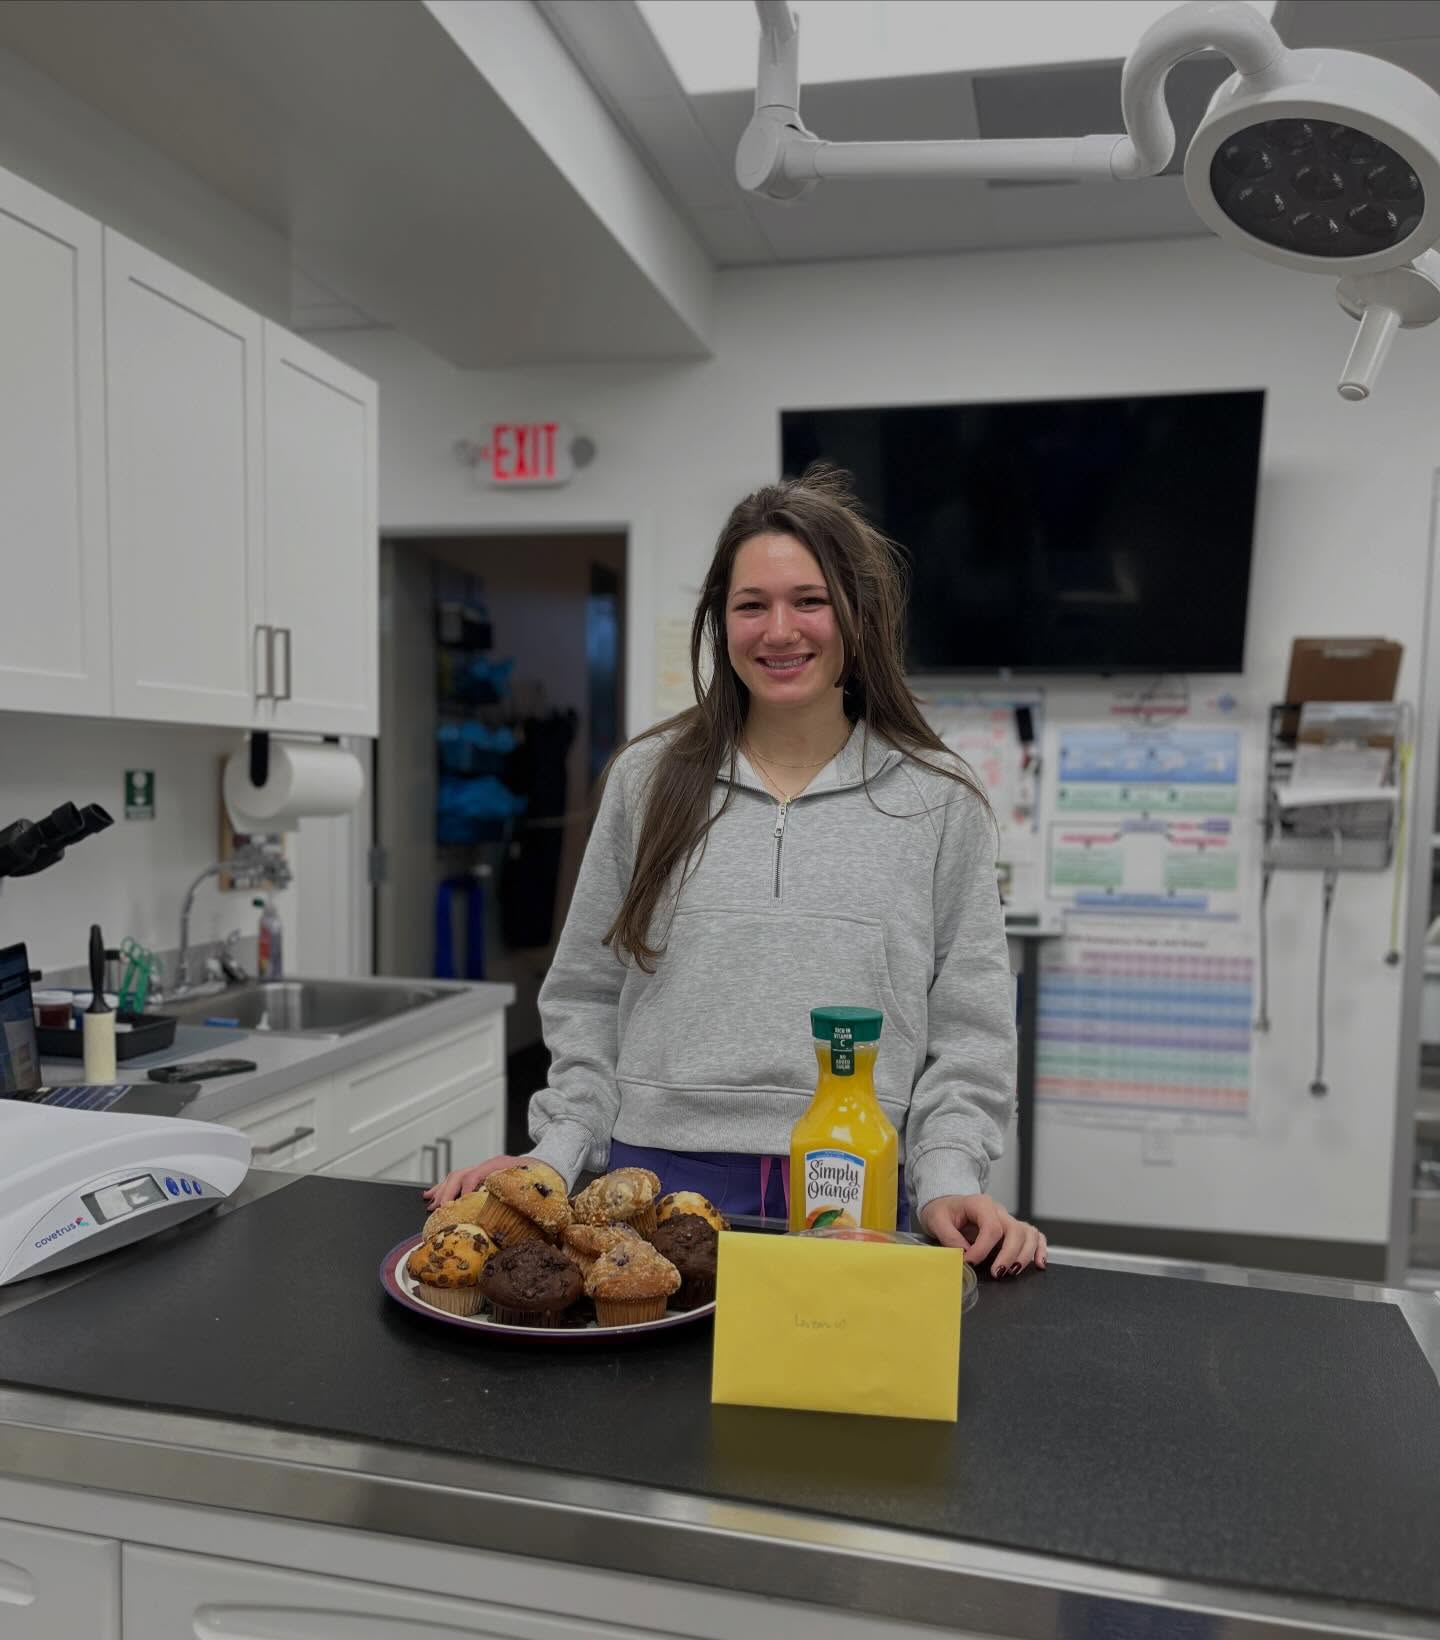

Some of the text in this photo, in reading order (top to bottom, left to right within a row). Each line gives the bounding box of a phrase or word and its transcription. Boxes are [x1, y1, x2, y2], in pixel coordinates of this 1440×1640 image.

[491, 422, 560, 481] EXIT
[808, 1159, 858, 1187] Simply
[807, 1181, 859, 1204] Orange
[34, 1223, 77, 1249] covetrus
